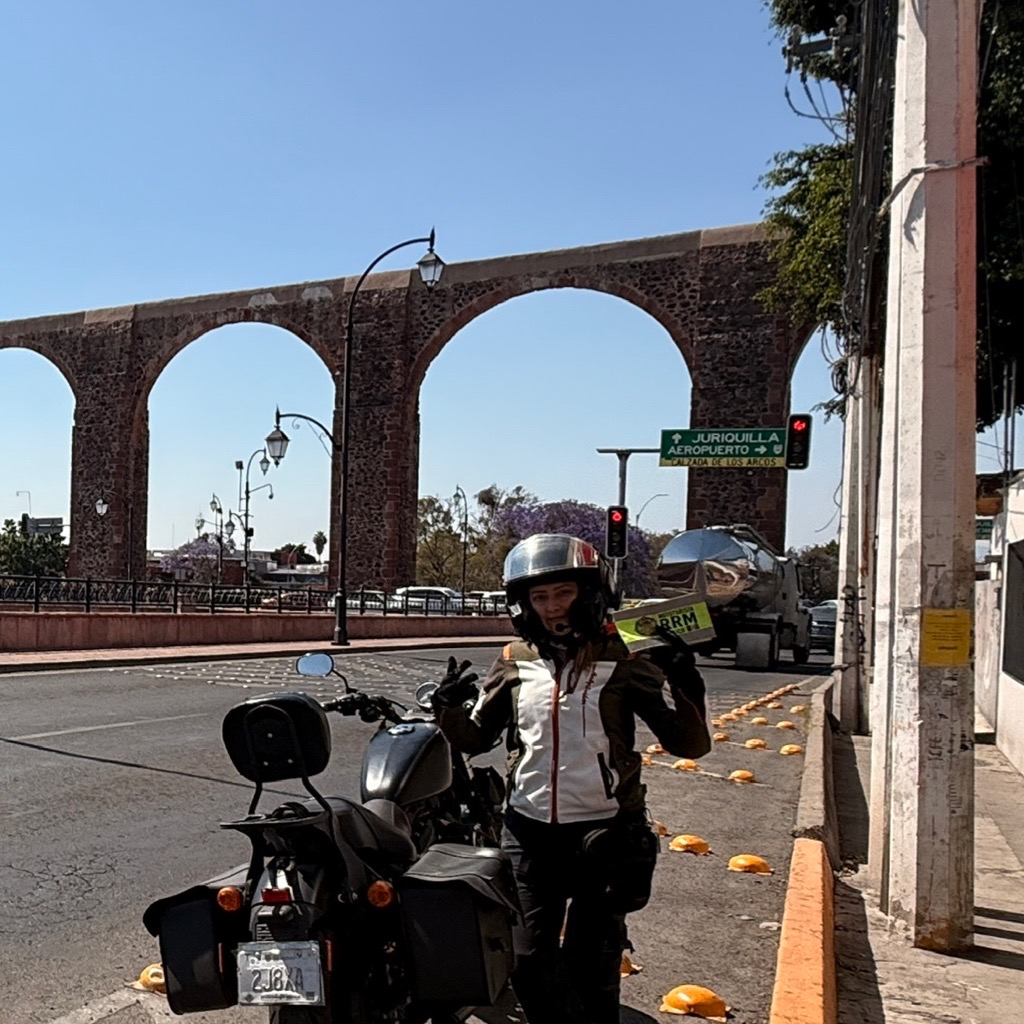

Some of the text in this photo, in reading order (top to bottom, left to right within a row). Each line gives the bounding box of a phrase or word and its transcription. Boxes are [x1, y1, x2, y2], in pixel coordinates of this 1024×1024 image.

[691, 432, 780, 444] JURIQUILLA
[667, 444, 750, 455] AEROPUERTO
[671, 458, 777, 467] CALZADA DE LOS ARCOS
[659, 612, 698, 630] RRM
